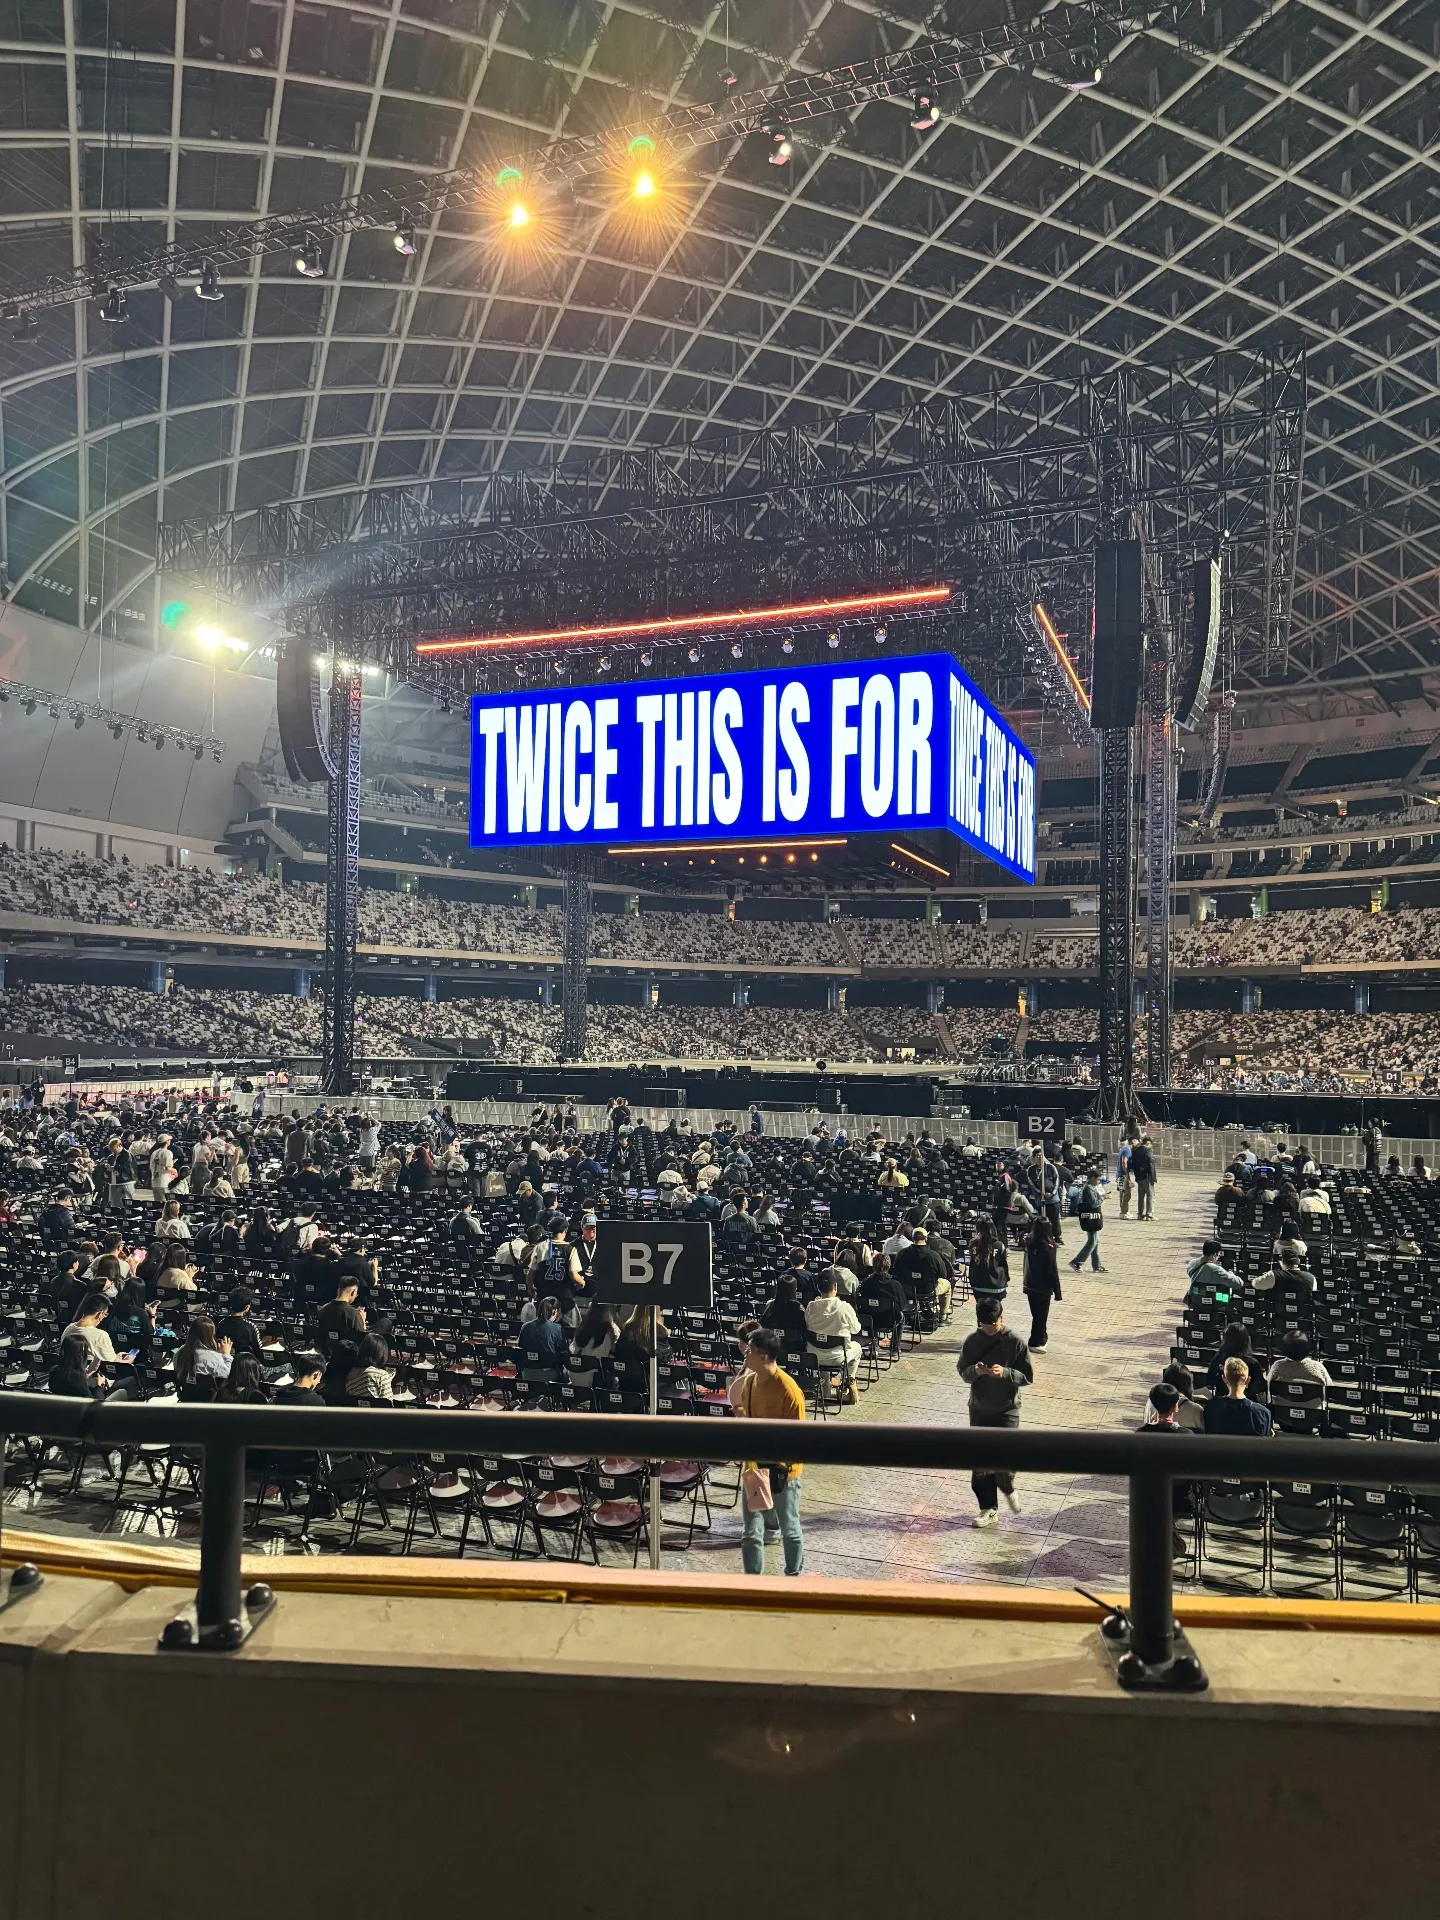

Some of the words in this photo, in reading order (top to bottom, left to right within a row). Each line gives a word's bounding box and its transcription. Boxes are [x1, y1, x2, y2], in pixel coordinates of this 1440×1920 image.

[479, 699, 619, 835] TWICE
[636, 687, 743, 828] THIS
[762, 681, 811, 822] IS
[831, 671, 934, 819] FOR
[950, 672, 984, 838] TWICE
[984, 715, 1006, 853] THIS
[1006, 741, 1017, 861] IS
[1017, 753, 1034, 873] FOR
[65, 1057, 75, 1065] B4
[1386, 1072, 1397, 1080] D1
[1028, 1116, 1055, 1133] B2
[544, 1257, 566, 1281] 25
[621, 1242, 684, 1285] B7
